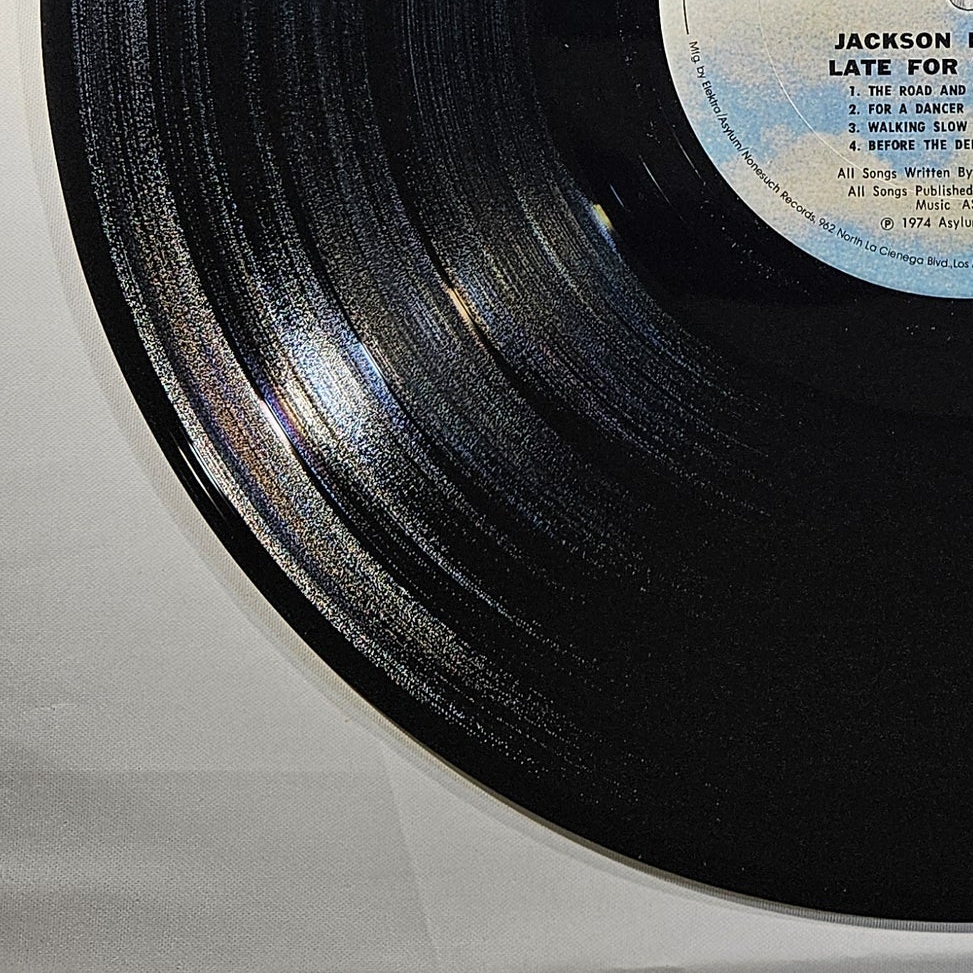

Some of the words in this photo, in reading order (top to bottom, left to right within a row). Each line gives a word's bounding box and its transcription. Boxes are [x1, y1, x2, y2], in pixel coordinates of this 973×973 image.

[835, 32, 951, 50] JACKSON
[829, 59, 892, 76] LATE
[907, 58, 958, 75] FOR
[849, 85, 861, 97] 1.
[868, 85, 892, 96] THE
[899, 85, 933, 96] ROAD
[939, 85, 966, 96] AND
[848, 104, 861, 115] 2.
[868, 104, 892, 114] FOR
[899, 104, 908, 114] A
[915, 103, 965, 114] DANCER
[848, 122, 861, 133] 3.
[868, 122, 926, 133] WALKING
[933, 121, 968, 132] SLOW
[849, 140, 861, 151] 4.
[868, 140, 916, 151] BEFORE
[923, 140, 947, 150] THE
[696, 65, 706, 79] by
[779, 190, 816, 224] Records,
[818, 217, 836, 234] 962
[837, 228, 863, 247] North
[864, 241, 877, 253] La
[879, 246, 924, 265] Cienega
[953, 258, 969, 269] Los
[837, 167, 855, 178] All
[862, 167, 897, 181] Songs
[904, 166, 950, 178] Written
[958, 166, 973, 180] By
[847, 185, 865, 197] All
[873, 185, 908, 199] Songs
[915, 184, 973, 196] Published
[915, 199, 951, 211] Music
[902, 217, 931, 229] 1974
